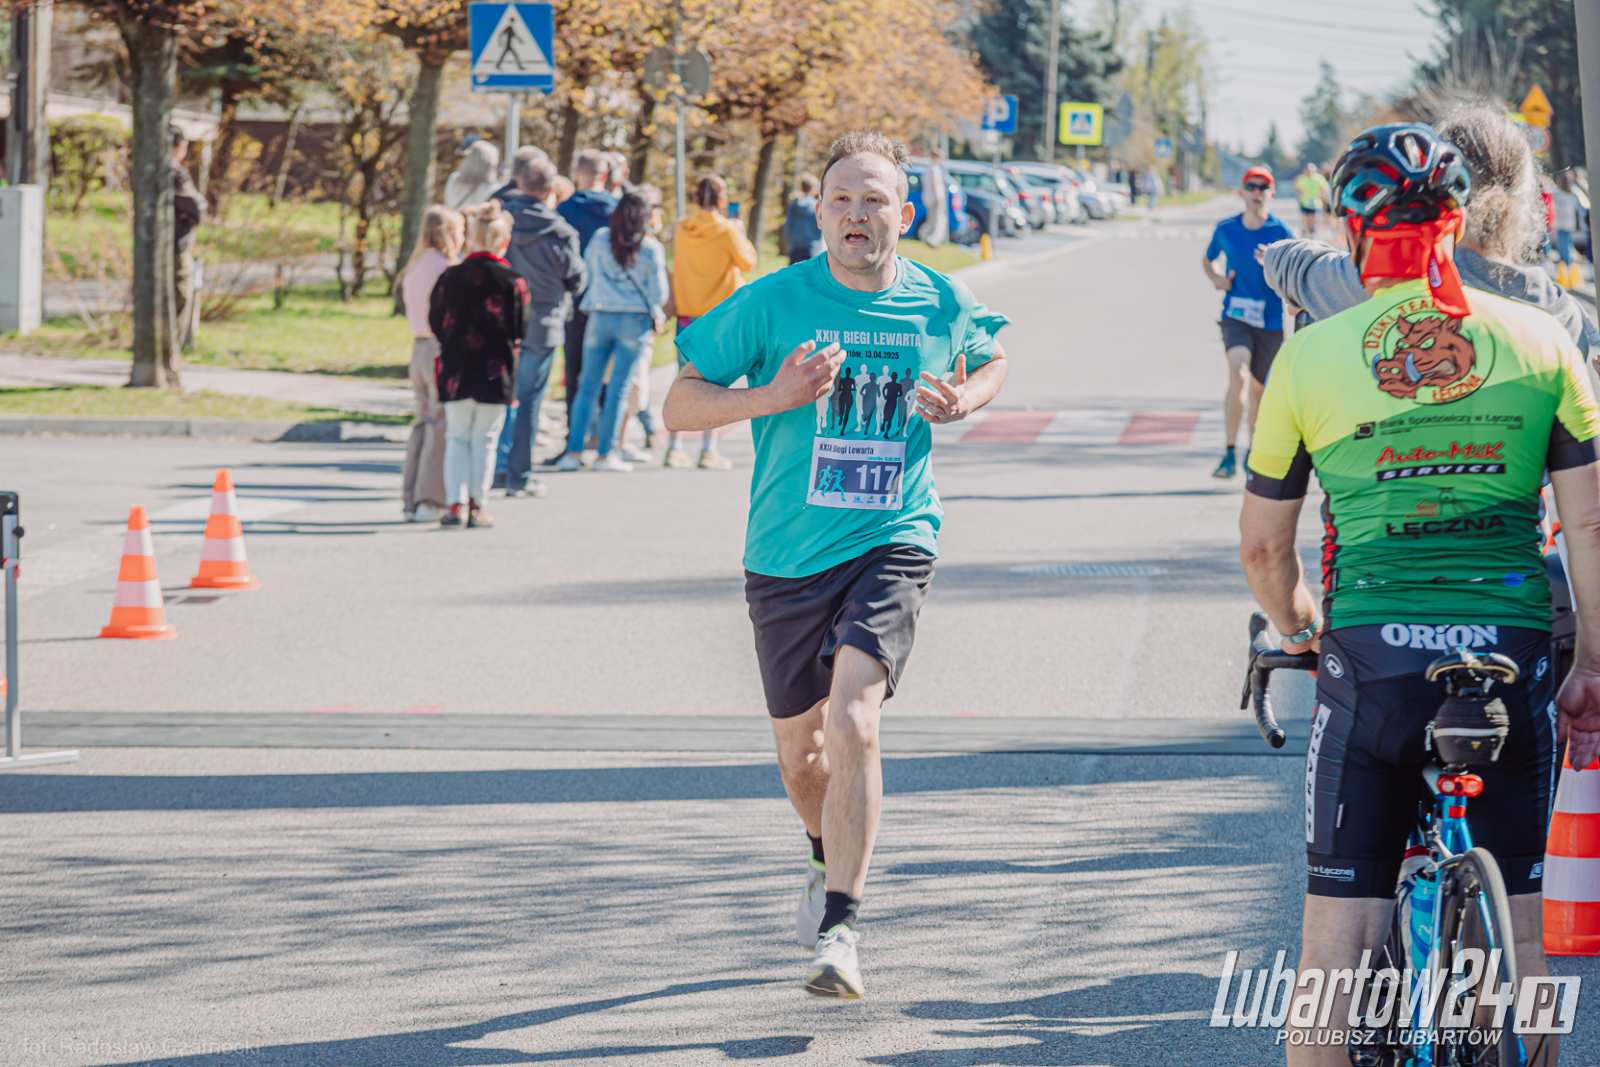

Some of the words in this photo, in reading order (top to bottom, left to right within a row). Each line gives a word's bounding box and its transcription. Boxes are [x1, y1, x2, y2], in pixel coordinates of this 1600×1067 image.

[1397, 299, 1437, 316] TEA
[816, 329, 840, 343] XXIX
[843, 331, 870, 345] BIEGI
[873, 332, 921, 348] LEWARTA
[848, 445, 874, 455] Lewarta
[856, 464, 899, 491] 117
[1382, 465, 1501, 480] SERVICE
[1386, 514, 1505, 538] ŁĘCZNA
